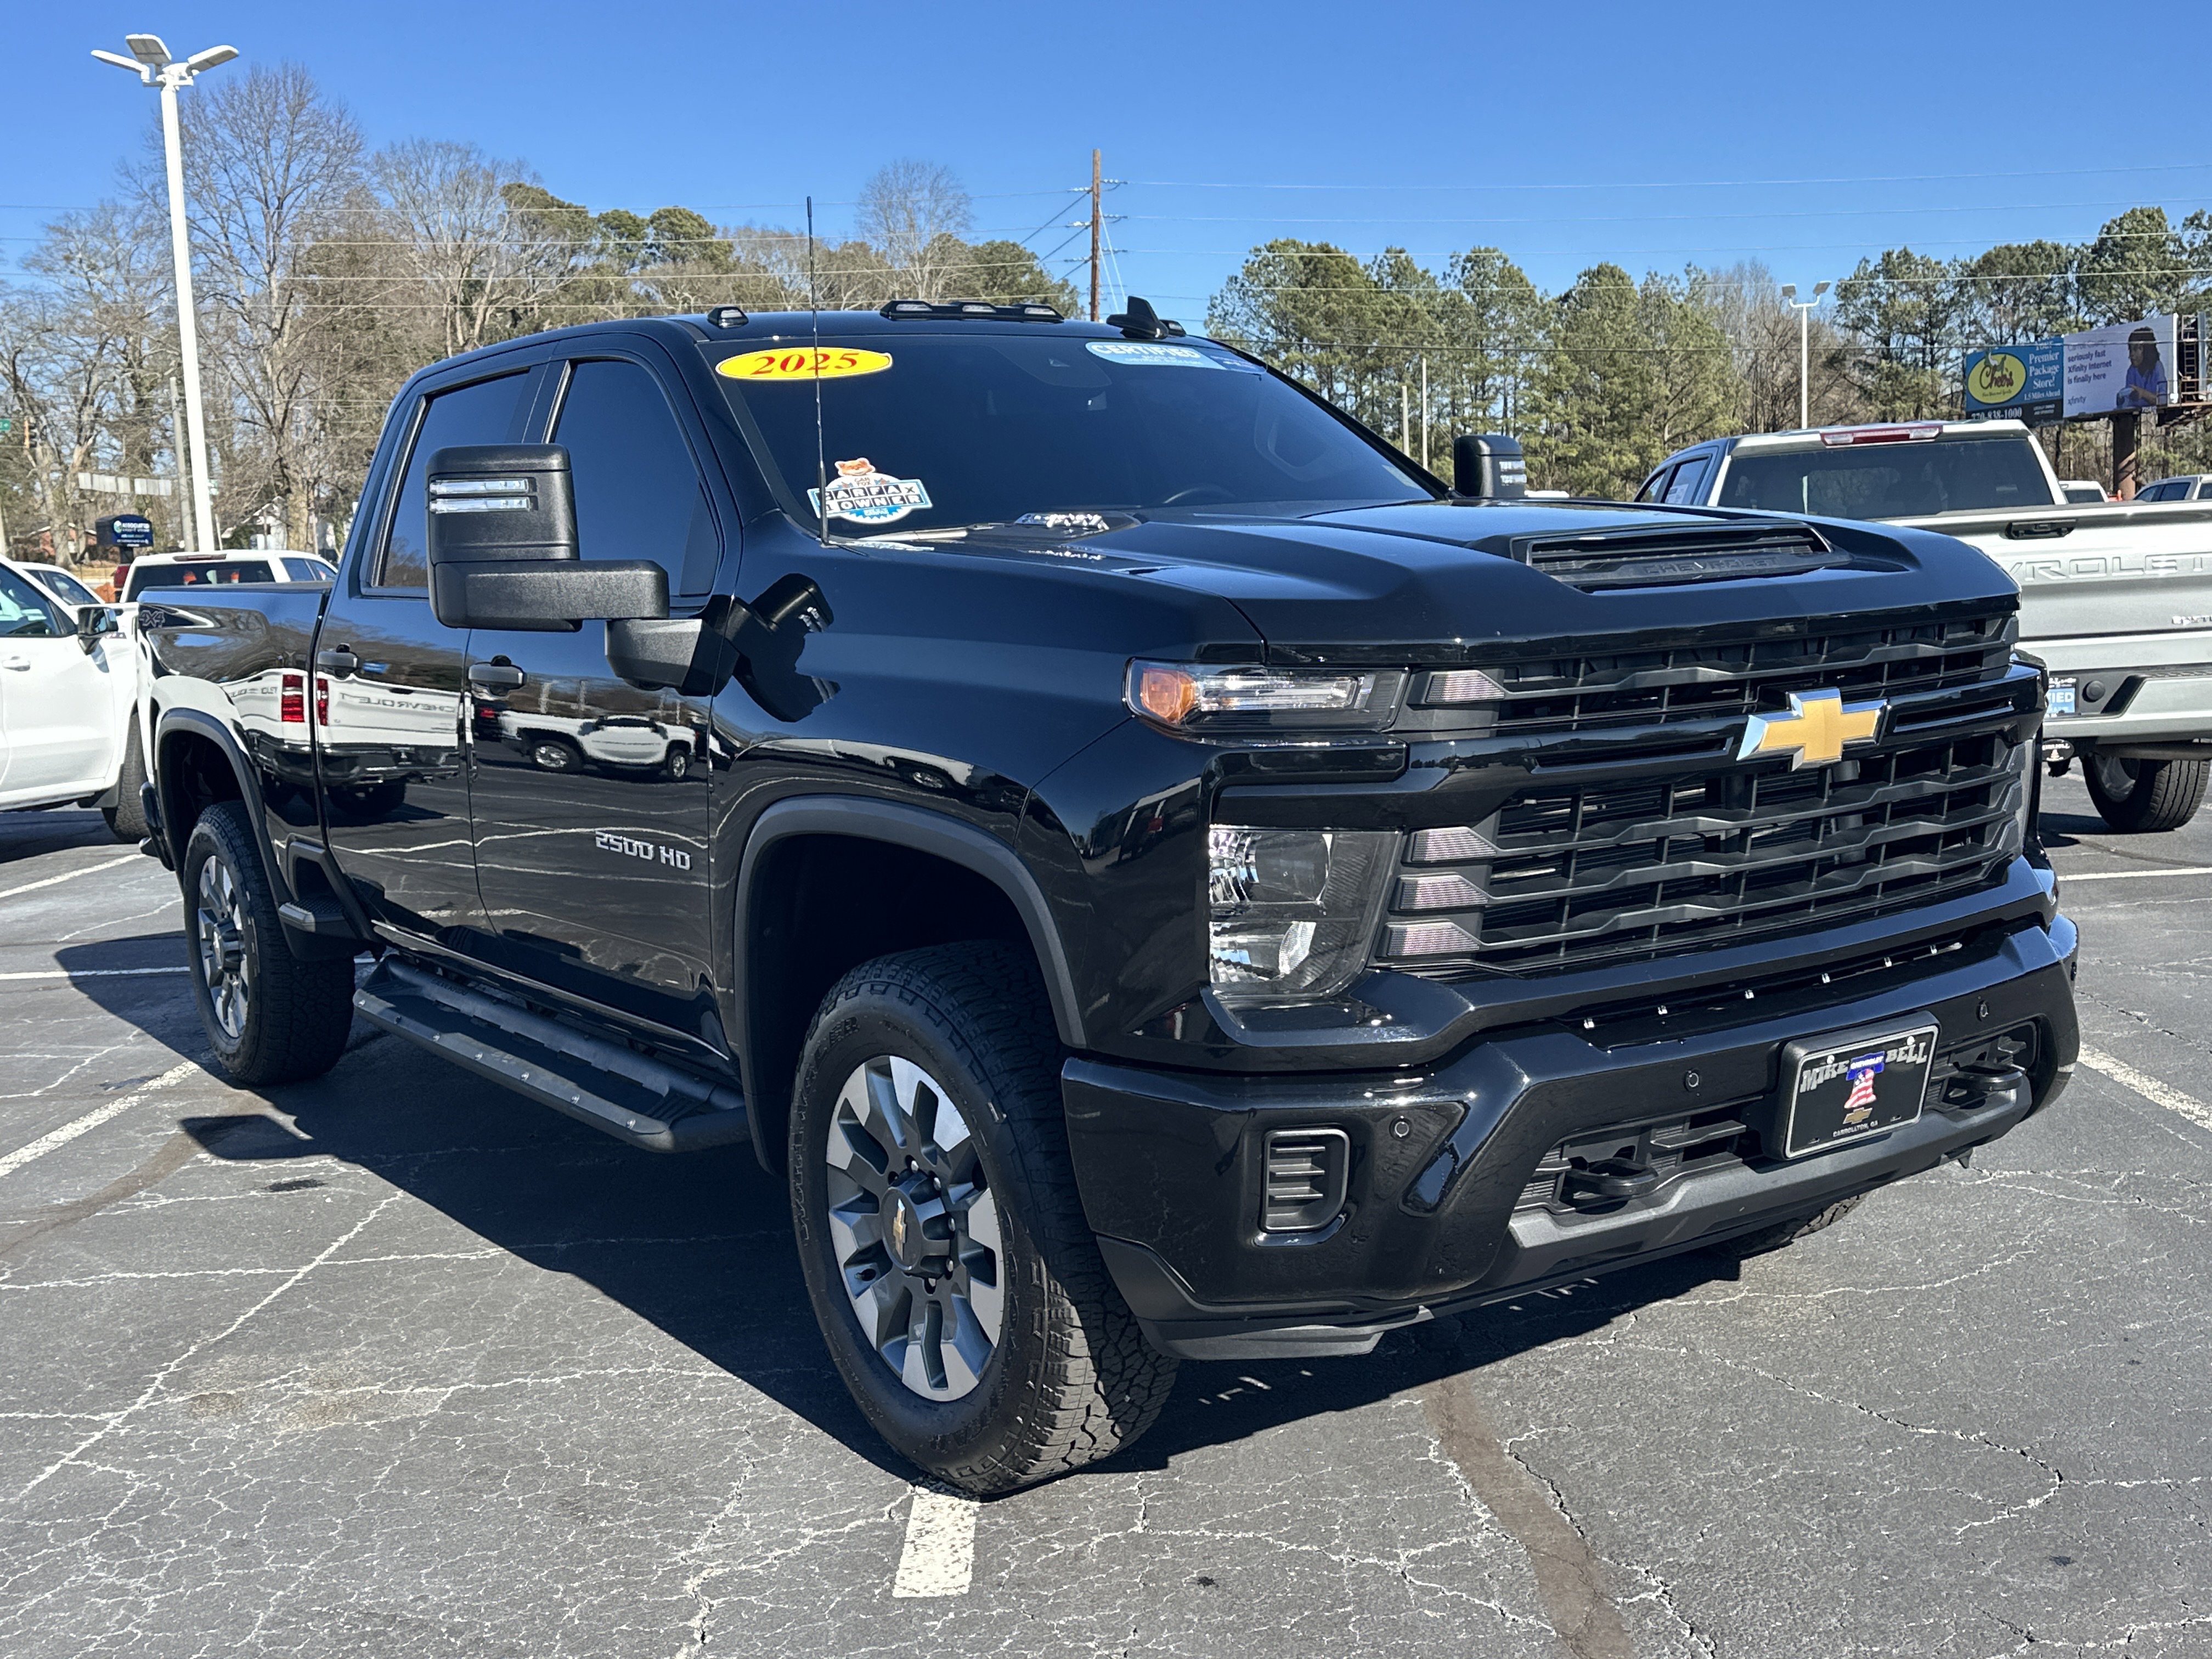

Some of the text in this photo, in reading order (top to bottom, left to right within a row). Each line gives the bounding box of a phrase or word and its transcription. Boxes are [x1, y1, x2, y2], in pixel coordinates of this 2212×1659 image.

[1091, 345, 1201, 358] CERTIFIED
[2029, 351, 2059, 364] Premier
[2068, 352, 2094, 362] seriously
[750, 353, 859, 375] 2025
[2029, 364, 2059, 377] Package
[2089, 360, 2112, 370] Internet
[2033, 376, 2055, 389] Store!
[2074, 374, 2091, 383] finally
[840, 495, 921, 510] OWNER
[1643, 557, 1777, 574] CHEVROLET
[595, 831, 691, 871] 2500 HD
[1799, 1042, 1927, 1093] MIKE BELL
